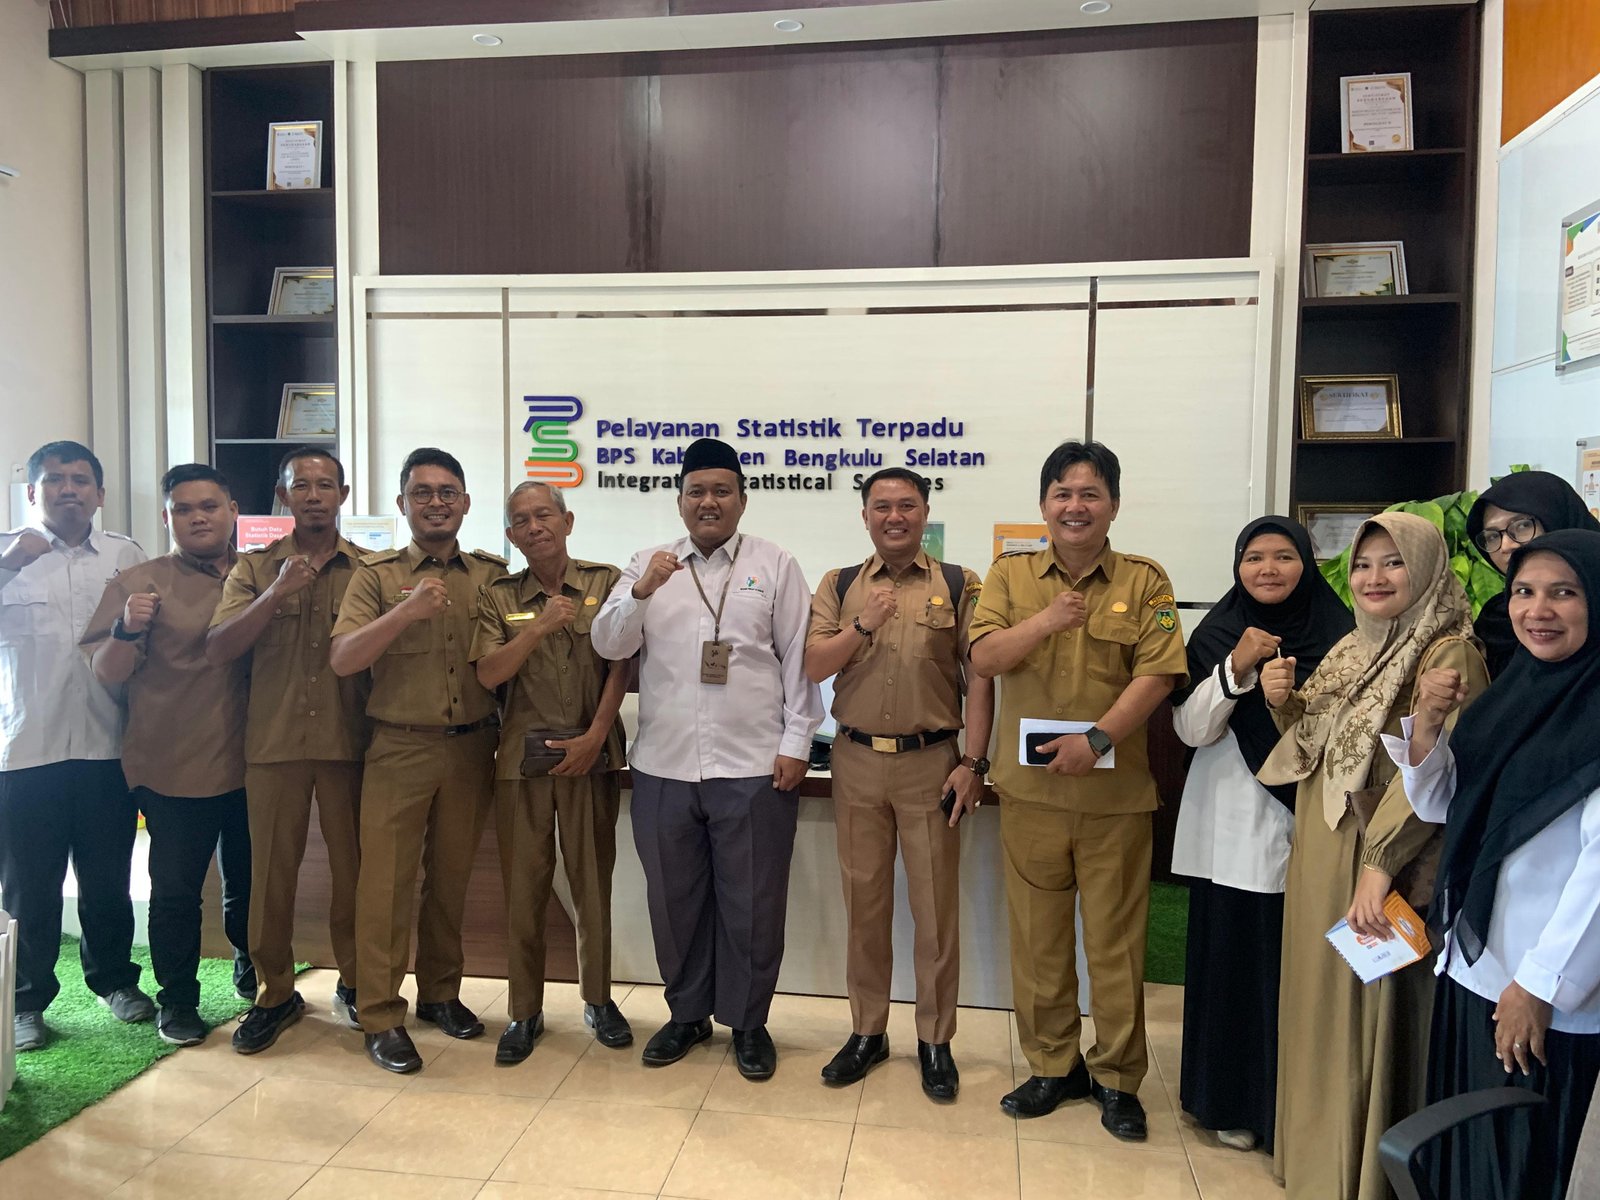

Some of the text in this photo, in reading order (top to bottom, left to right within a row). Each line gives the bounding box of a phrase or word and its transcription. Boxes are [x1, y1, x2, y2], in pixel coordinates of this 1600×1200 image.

[596, 416, 964, 441] Pelayanan Statistik Terpadu
[596, 446, 985, 471] BPS Kaben Bengkulu Selatan
[597, 470, 682, 492] Integrat
[742, 472, 833, 490] tatistical
